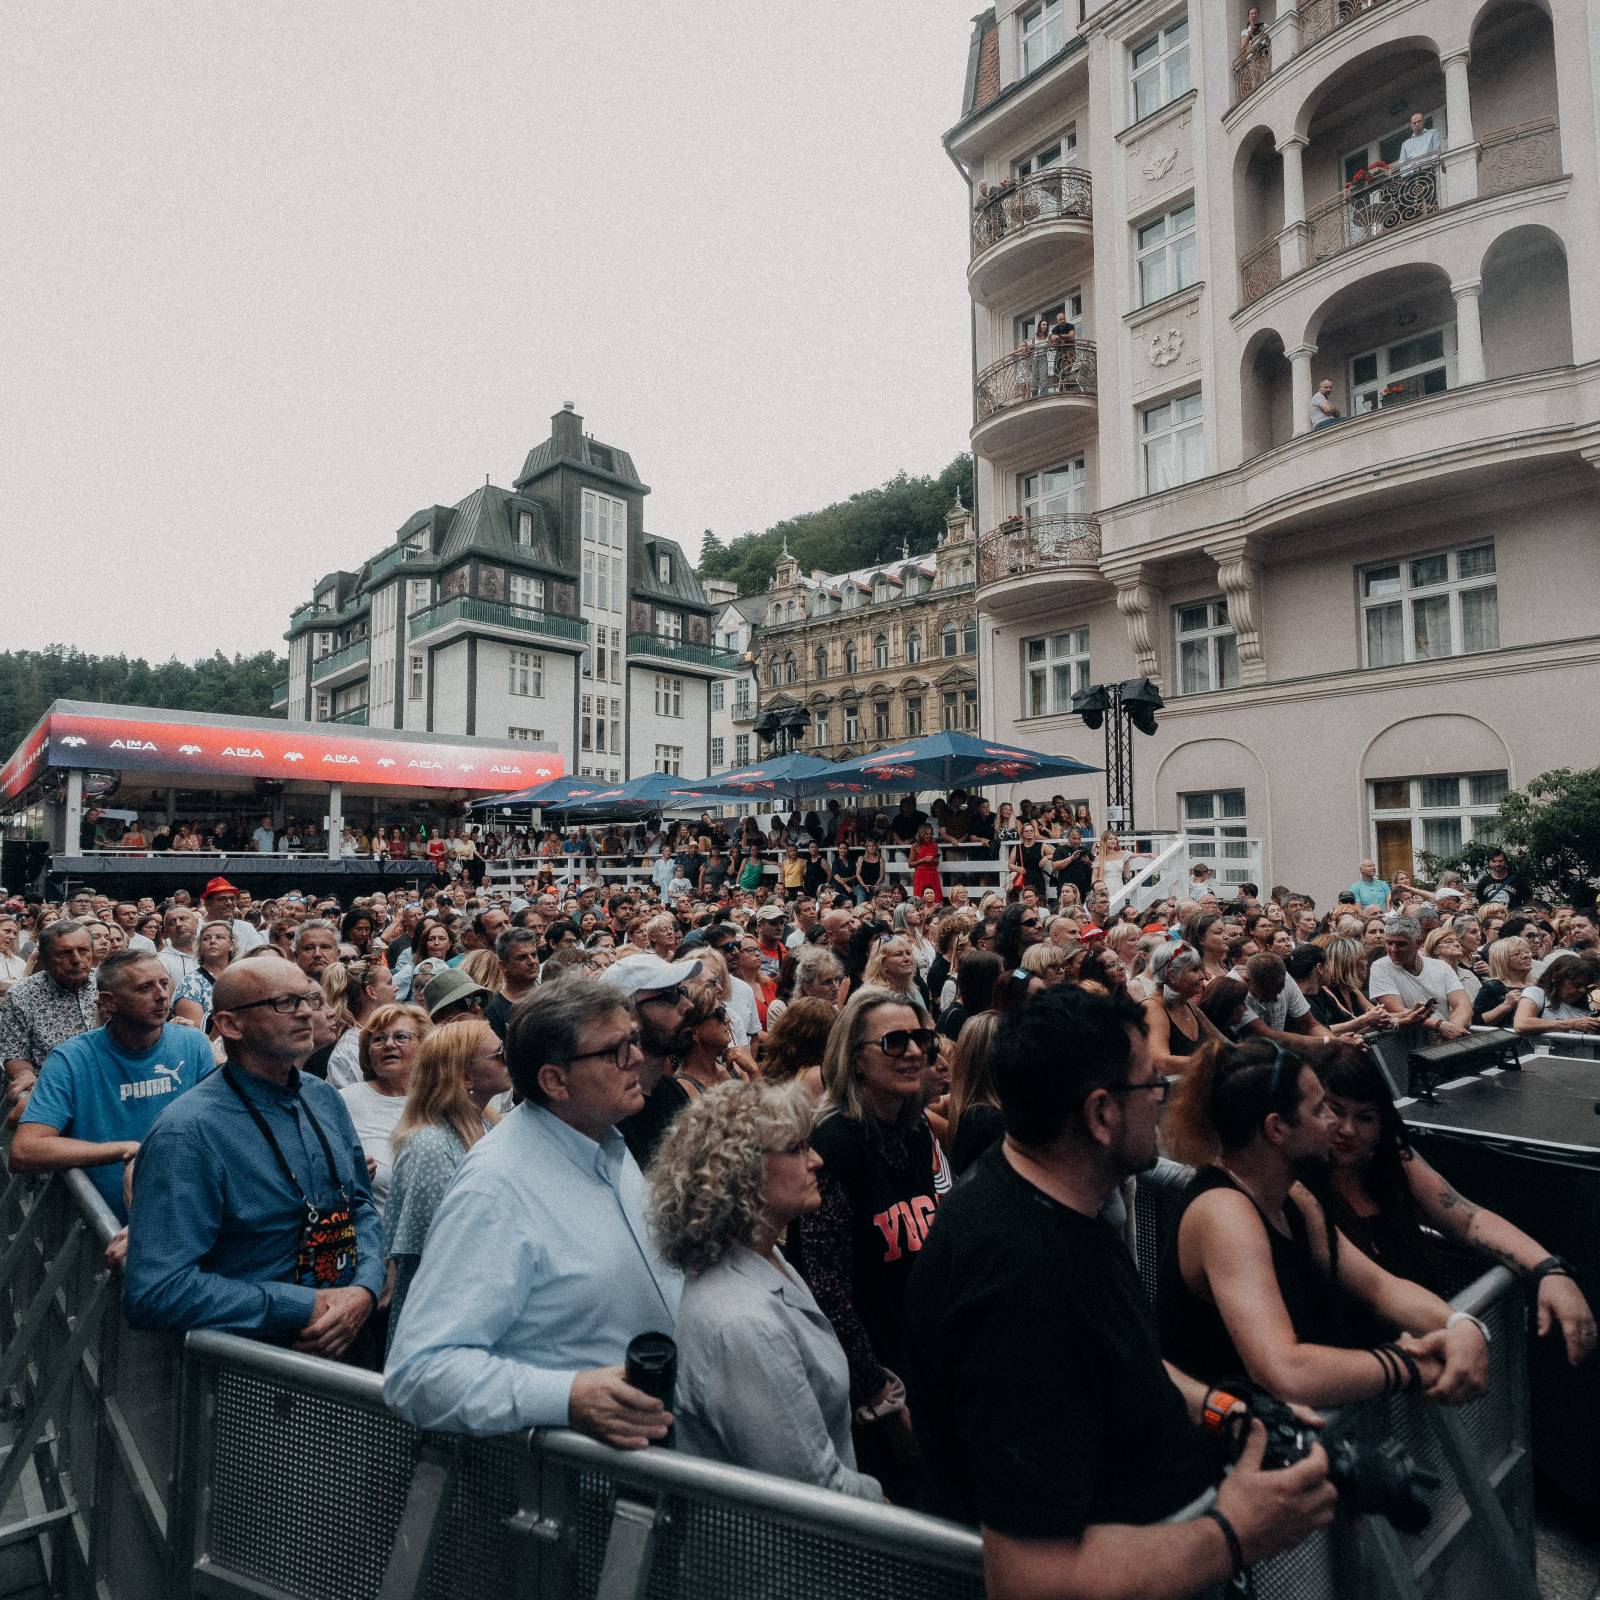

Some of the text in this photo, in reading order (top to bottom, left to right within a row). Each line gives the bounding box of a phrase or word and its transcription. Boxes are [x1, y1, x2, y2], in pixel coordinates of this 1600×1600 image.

[110, 739, 157, 751] ALMA
[222, 747, 265, 758] ALMA
[321, 753, 361, 765] ALMA
[120, 1076, 172, 1101] PUMA
